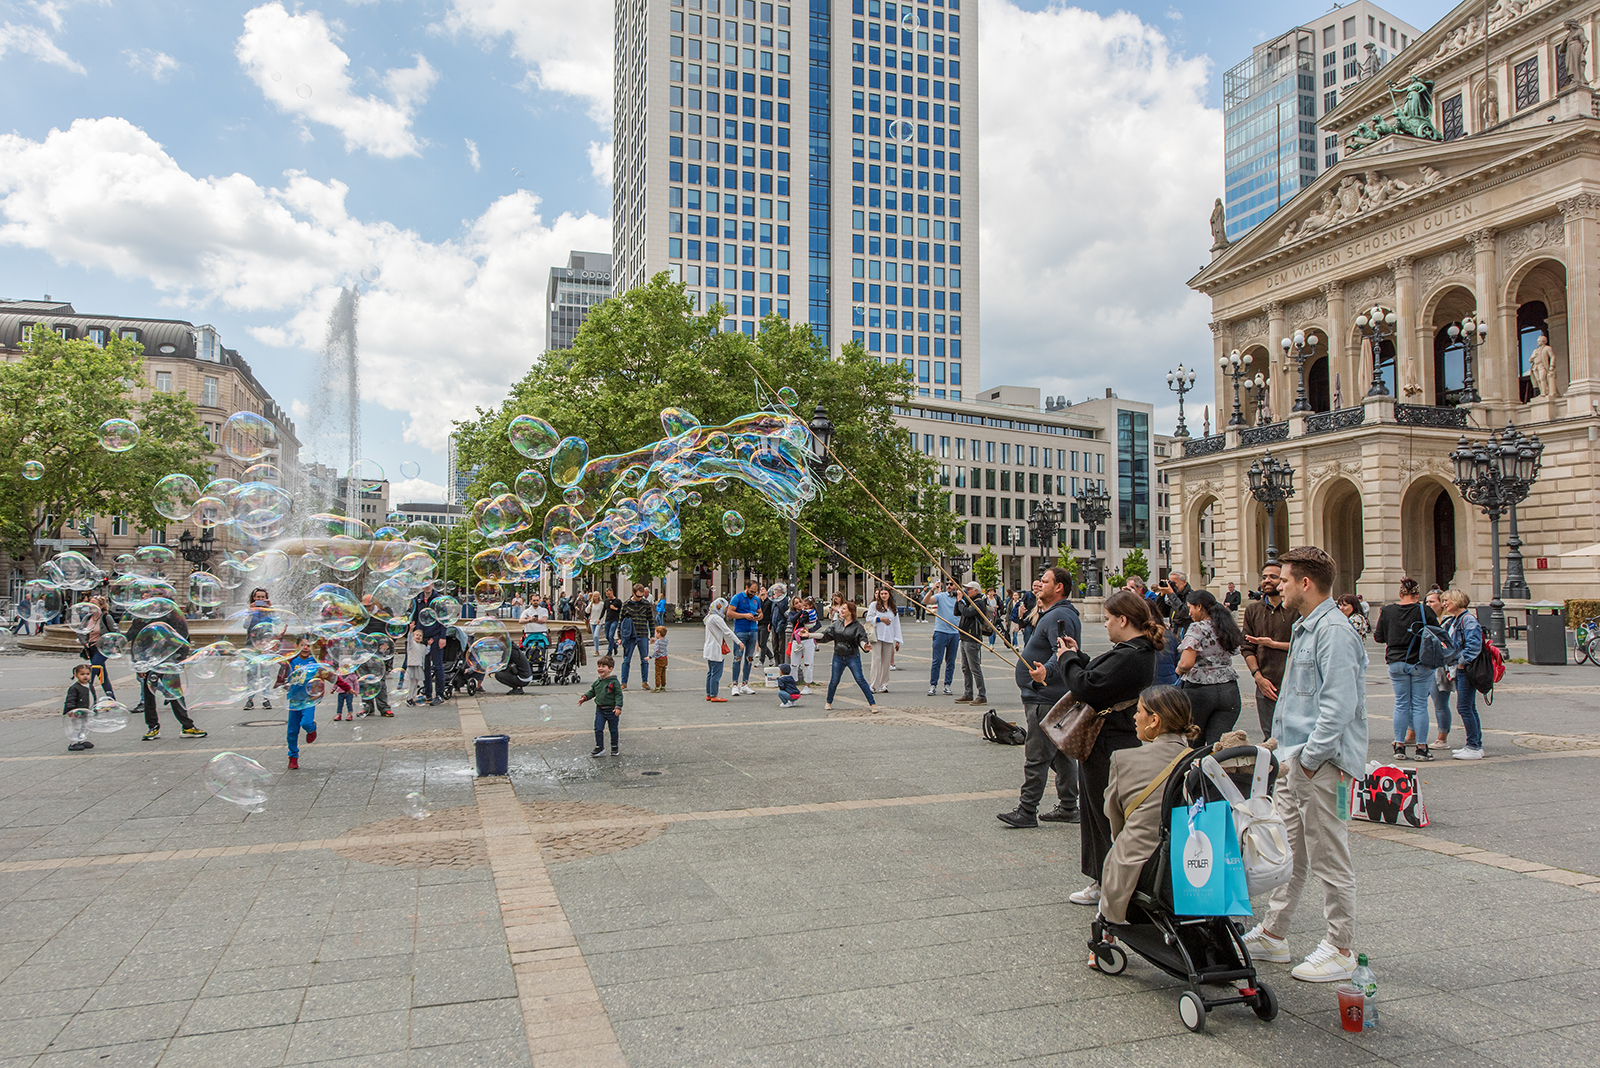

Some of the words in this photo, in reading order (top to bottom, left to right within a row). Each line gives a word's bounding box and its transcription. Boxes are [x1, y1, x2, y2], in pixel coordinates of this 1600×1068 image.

[1266, 271, 1288, 288] DEM
[1292, 251, 1340, 278] WAHREN
[1346, 223, 1416, 259] SCHOENEN
[1423, 202, 1478, 230] GUTEN.
[581, 271, 610, 280] ODDO
